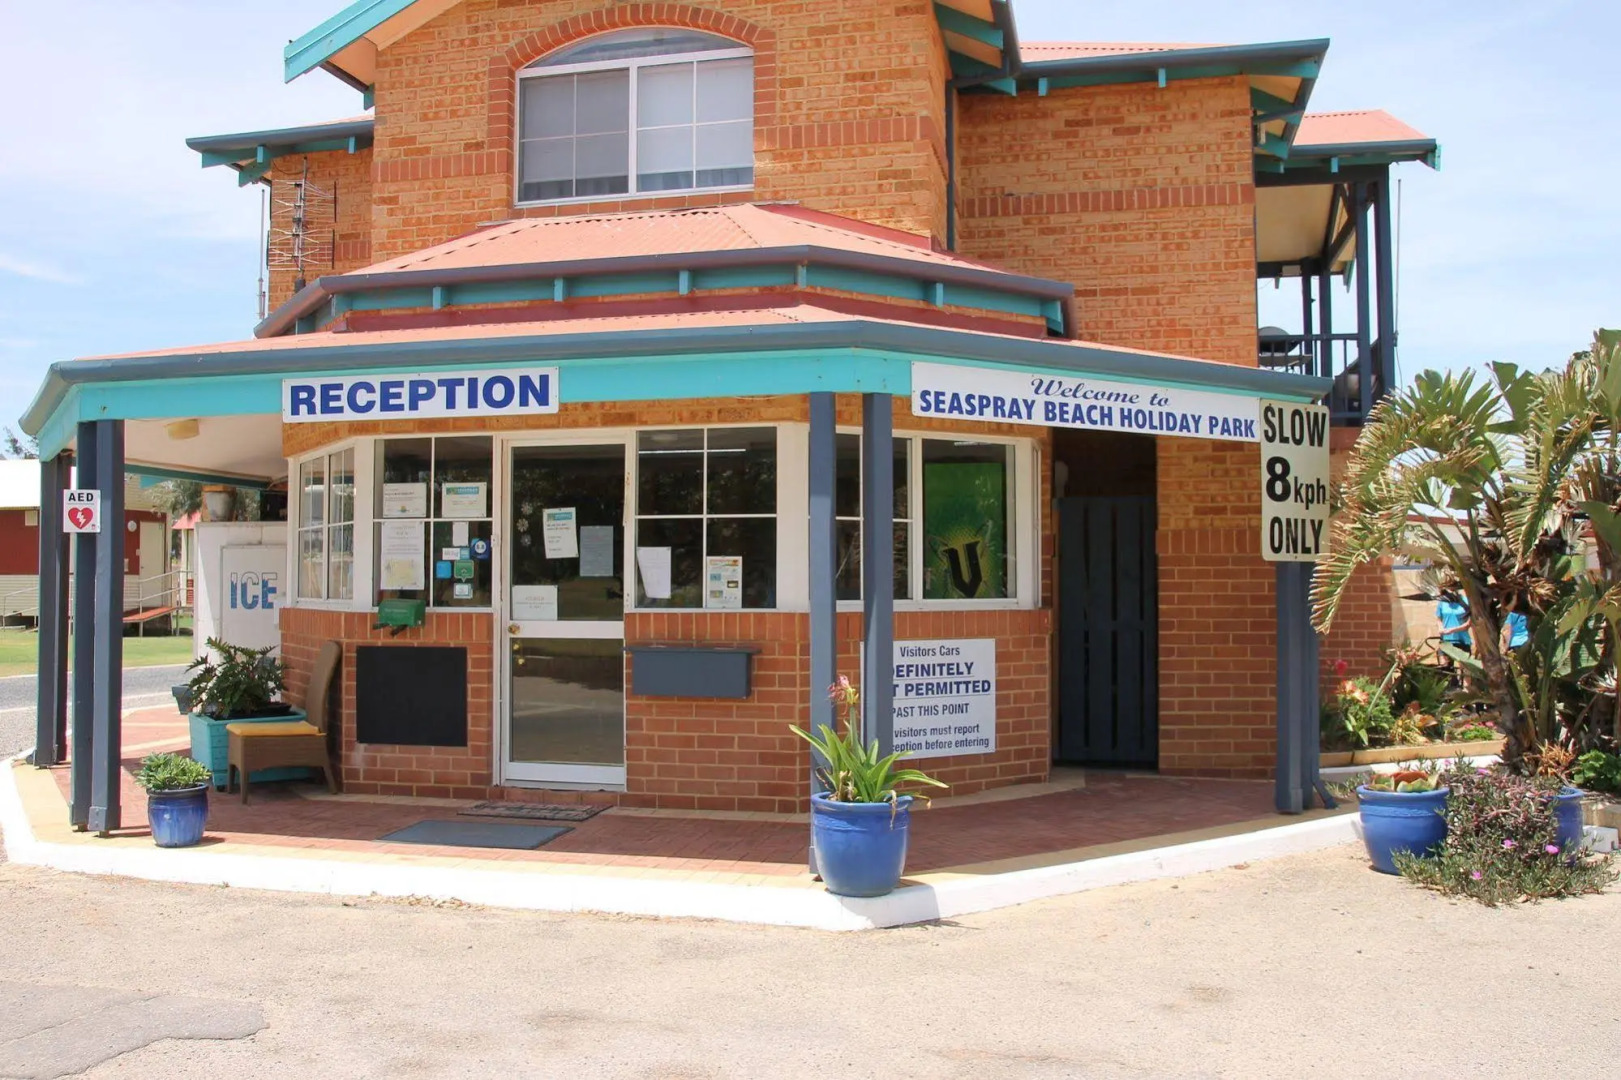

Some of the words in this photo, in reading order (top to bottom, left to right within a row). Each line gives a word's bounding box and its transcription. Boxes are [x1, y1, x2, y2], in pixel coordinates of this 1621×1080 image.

[289, 374, 550, 416] RECEPTION
[1031, 378, 1140, 405] Welcome
[1149, 392, 1169, 407] to
[919, 389, 1036, 421] SEASPRAY
[1044, 400, 1113, 427] BEACH
[1120, 407, 1202, 434] HOLIDAY
[1208, 415, 1256, 438] PARK
[1263, 404, 1327, 447] SLOW
[1265, 456, 1291, 502] 8
[1294, 476, 1326, 510] kph
[68, 492, 94, 502] AED
[1269, 516, 1323, 554] ONLY
[230, 571, 278, 610] ICE
[899, 645, 937, 658] Visitors
[939, 644, 961, 656] Cars
[892, 661, 975, 679] EFINITELY
[904, 679, 992, 697] PERMITTED
[917, 704, 940, 717] THIS
[942, 702, 970, 715] POINT
[894, 727, 928, 739] visitors
[930, 725, 952, 736] must
[954, 723, 980, 736] report
[925, 739, 953, 750] before
[954, 737, 990, 750] entering
